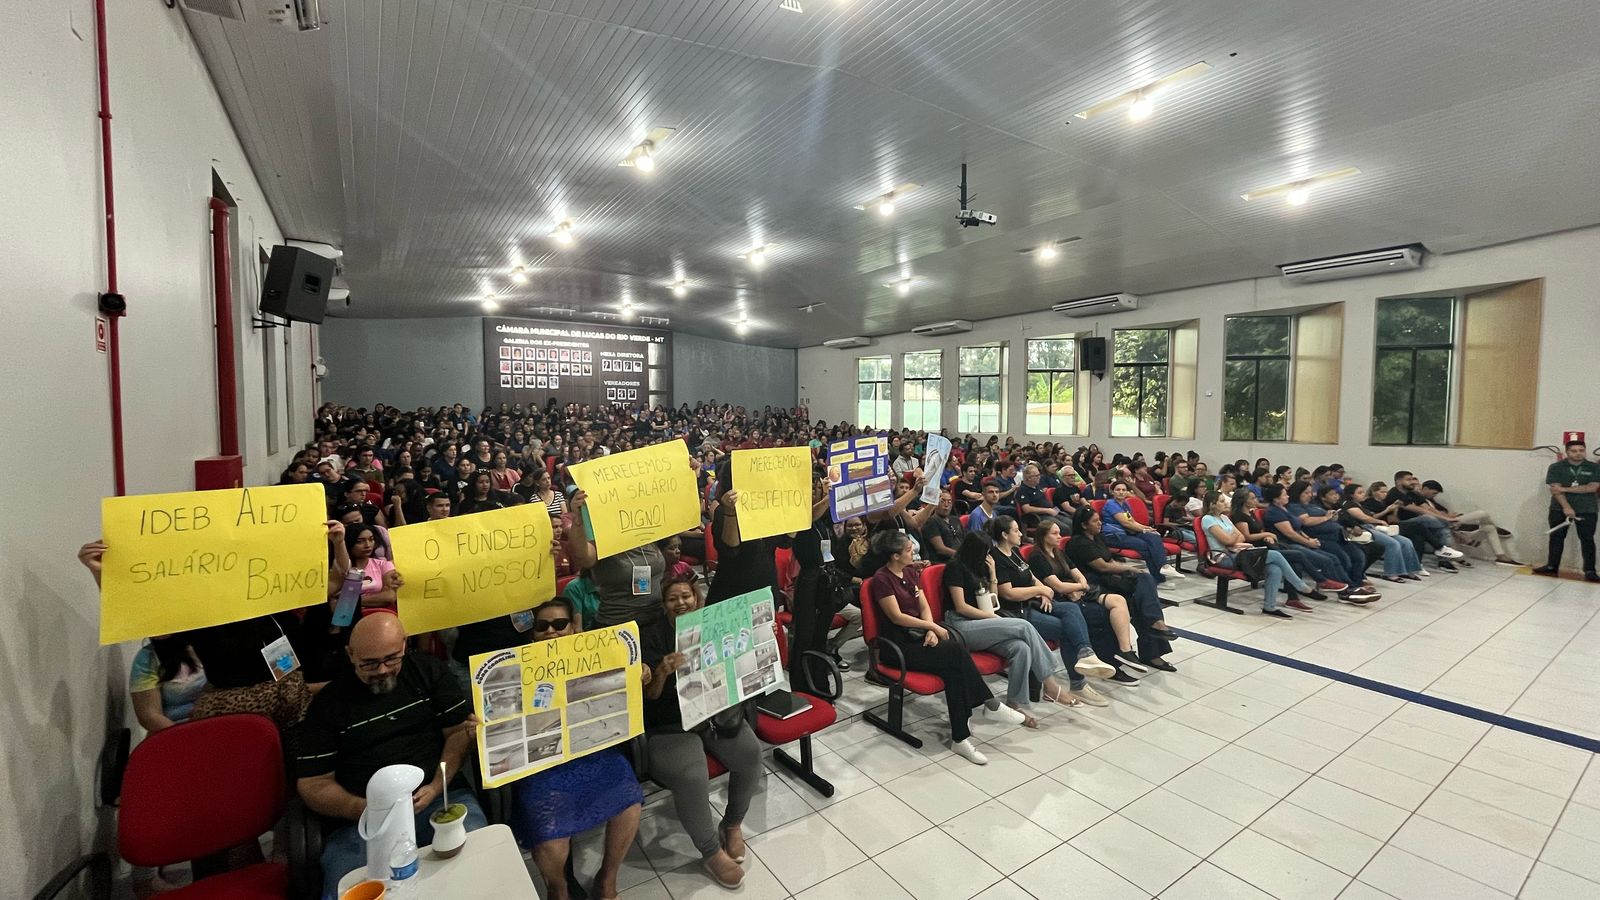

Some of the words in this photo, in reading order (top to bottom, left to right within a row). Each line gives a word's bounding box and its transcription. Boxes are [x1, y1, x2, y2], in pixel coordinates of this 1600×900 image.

[495, 324, 529, 334] CÂMARA
[530, 328, 570, 336] MUNICIPAL
[581, 331, 604, 339] LUCAS
[629, 334, 650, 342] VERDE
[592, 457, 672, 485] MERECEMOS
[749, 454, 801, 472] MERECEMOS
[598, 487, 620, 505] UM
[627, 476, 678, 500] SALÁRIO
[140, 506, 211, 535] IDEB
[619, 503, 666, 531] DIGNO!
[424, 538, 440, 561] O
[456, 523, 538, 556] FUNDEB
[129, 549, 238, 584] SALÁRIO
[423, 571, 445, 600] É
[462, 553, 542, 594] NOSSO!
[573, 629, 619, 653] CORA
[521, 652, 602, 686] CORALINA
